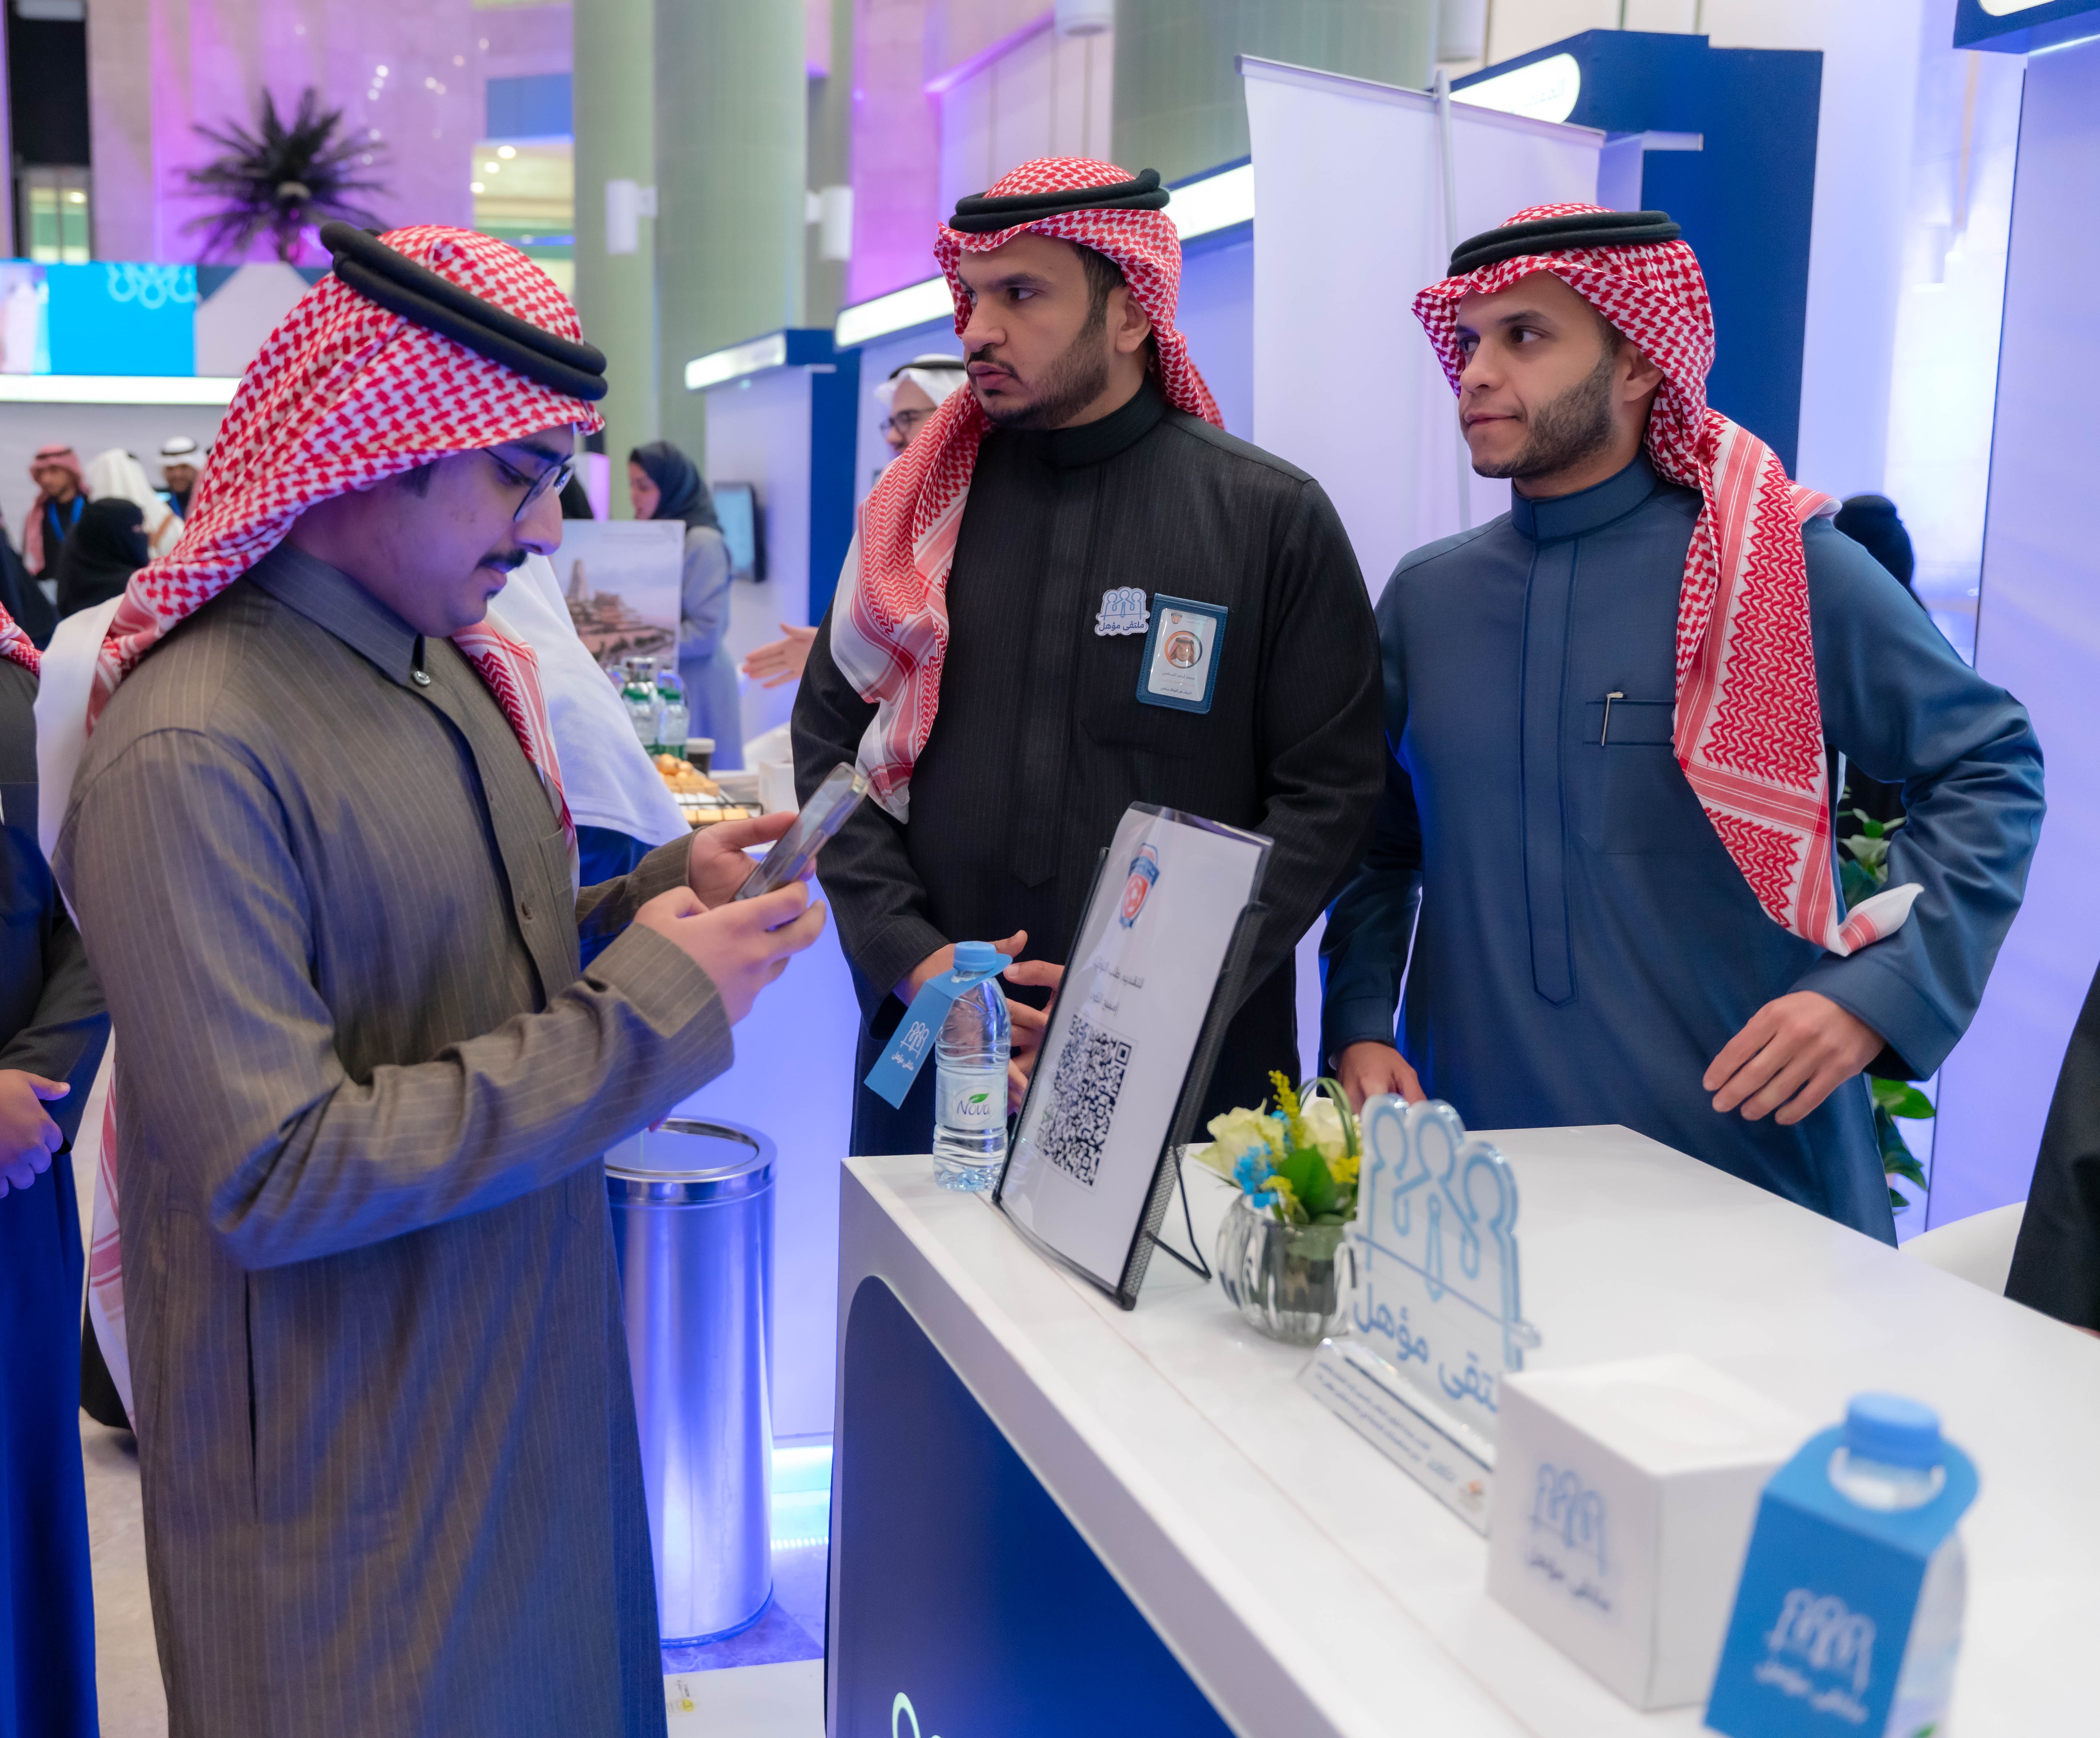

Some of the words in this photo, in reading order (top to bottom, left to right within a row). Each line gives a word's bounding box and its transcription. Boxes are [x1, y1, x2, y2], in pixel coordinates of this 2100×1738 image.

[1099, 622, 1121, 631] مؤهل
[1123, 621, 1144, 631] ملتقى
[957, 1100, 990, 1115] Nova
[1437, 1350, 1498, 1413] تقى
